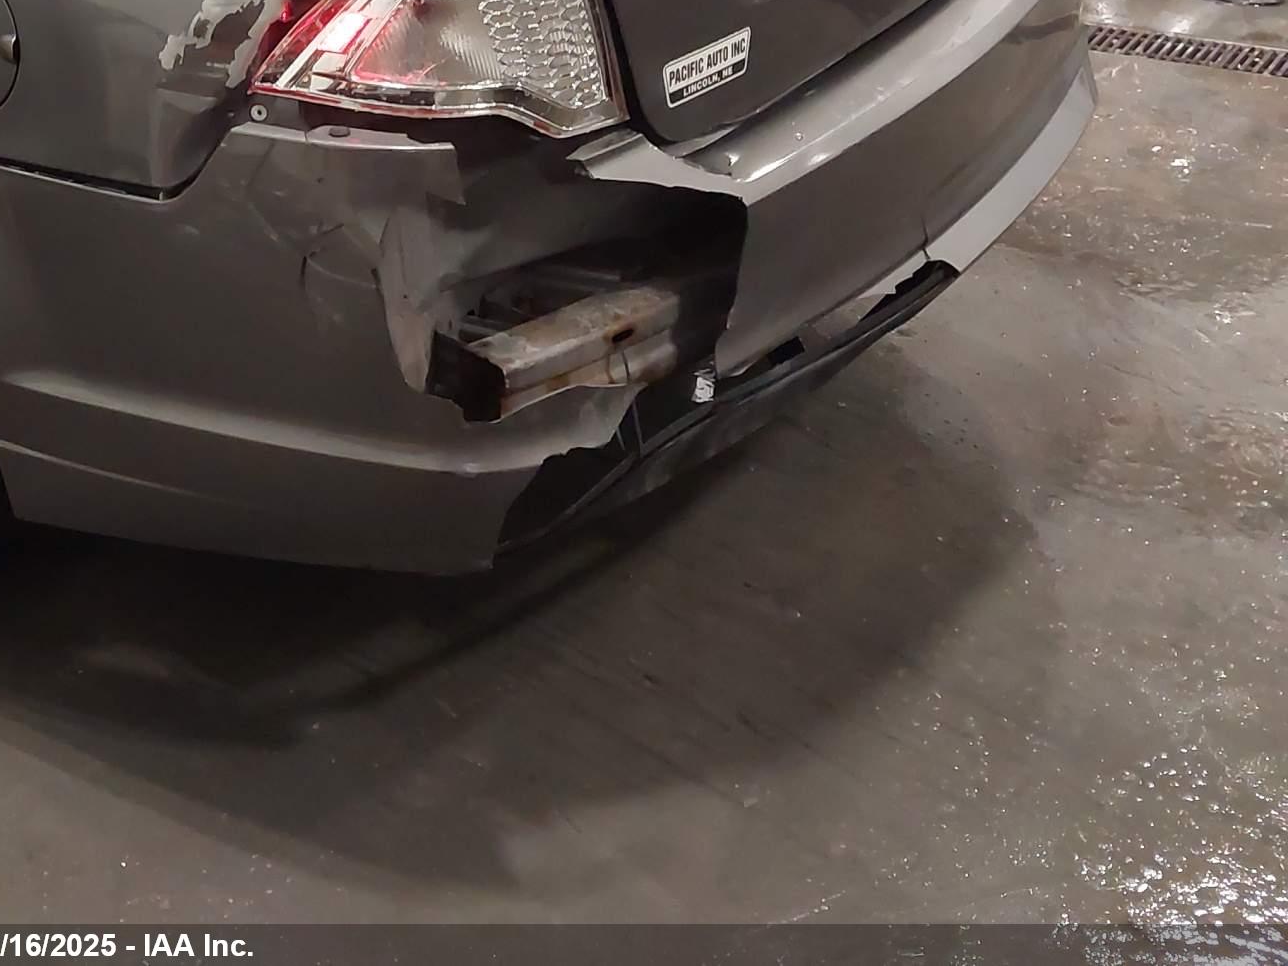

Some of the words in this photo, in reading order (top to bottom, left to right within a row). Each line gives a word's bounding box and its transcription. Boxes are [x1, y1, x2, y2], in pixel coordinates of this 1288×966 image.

[669, 57, 704, 88] PACIFIC
[706, 46, 729, 70] AUTO
[731, 38, 746, 58] INC
[683, 73, 721, 97] LINCOLN,
[722, 65, 734, 79] NE
